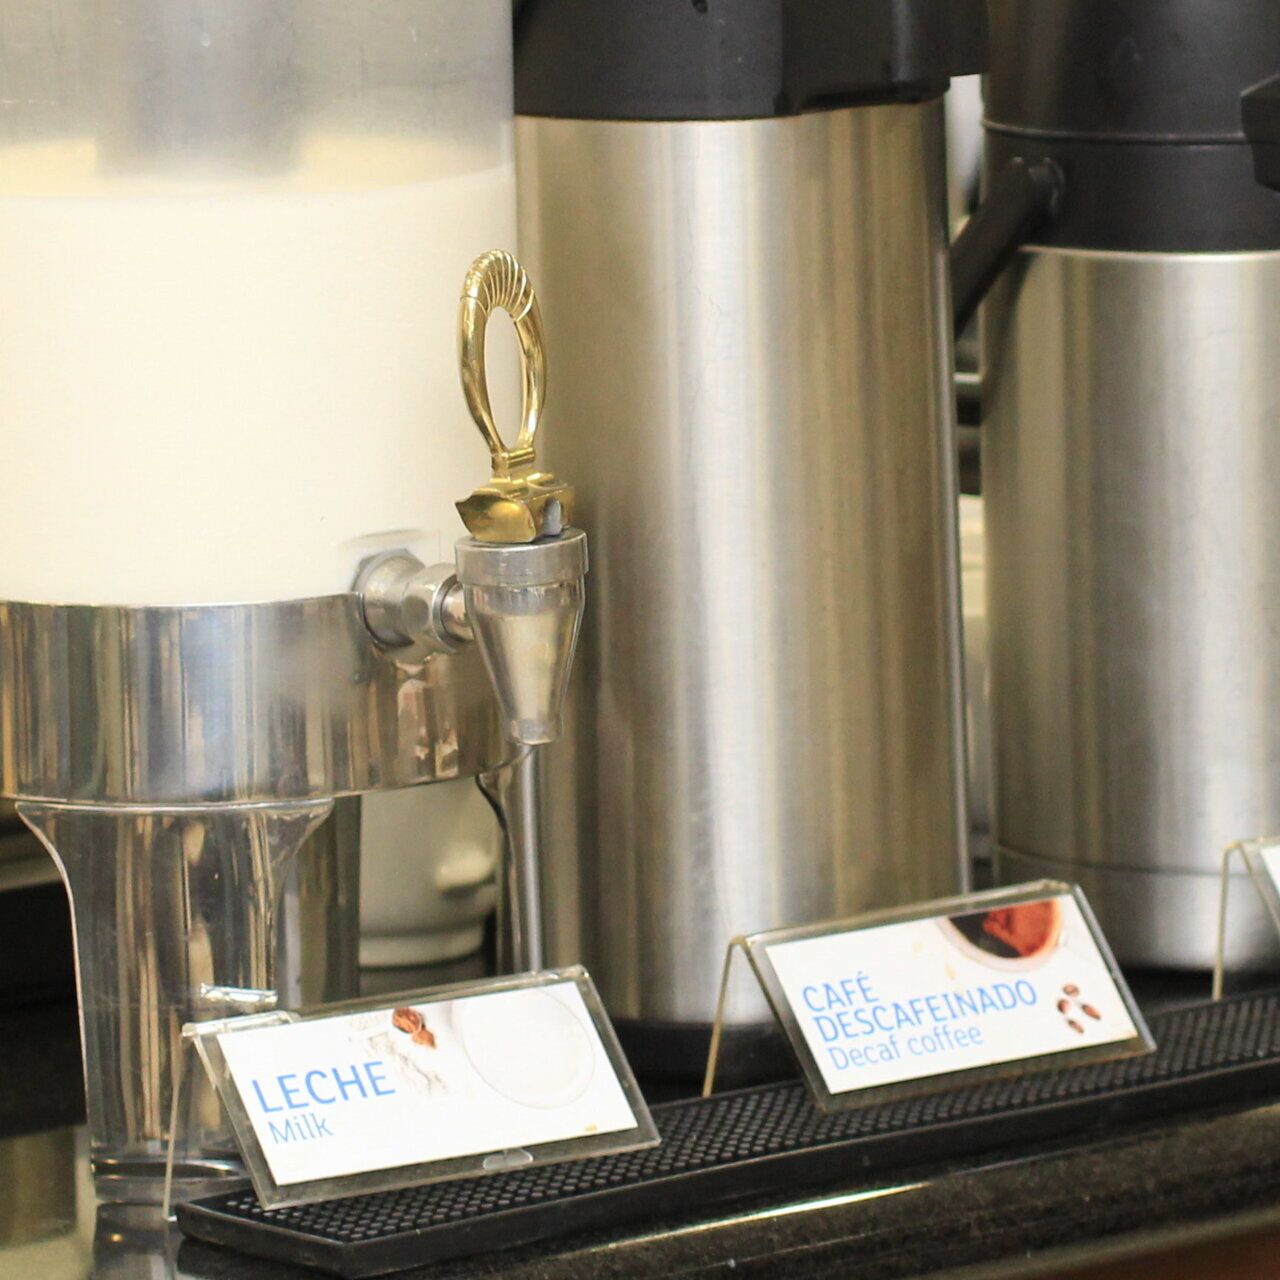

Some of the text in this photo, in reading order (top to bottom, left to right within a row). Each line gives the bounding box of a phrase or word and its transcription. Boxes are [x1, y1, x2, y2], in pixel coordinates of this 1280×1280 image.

[802, 970, 881, 1013] CAFÉ
[812, 979, 1038, 1043] DESCAFEINADO
[827, 1023, 985, 1071] Decaf coffee
[251, 1060, 397, 1113] LECHE
[267, 1112, 334, 1145] Milk
